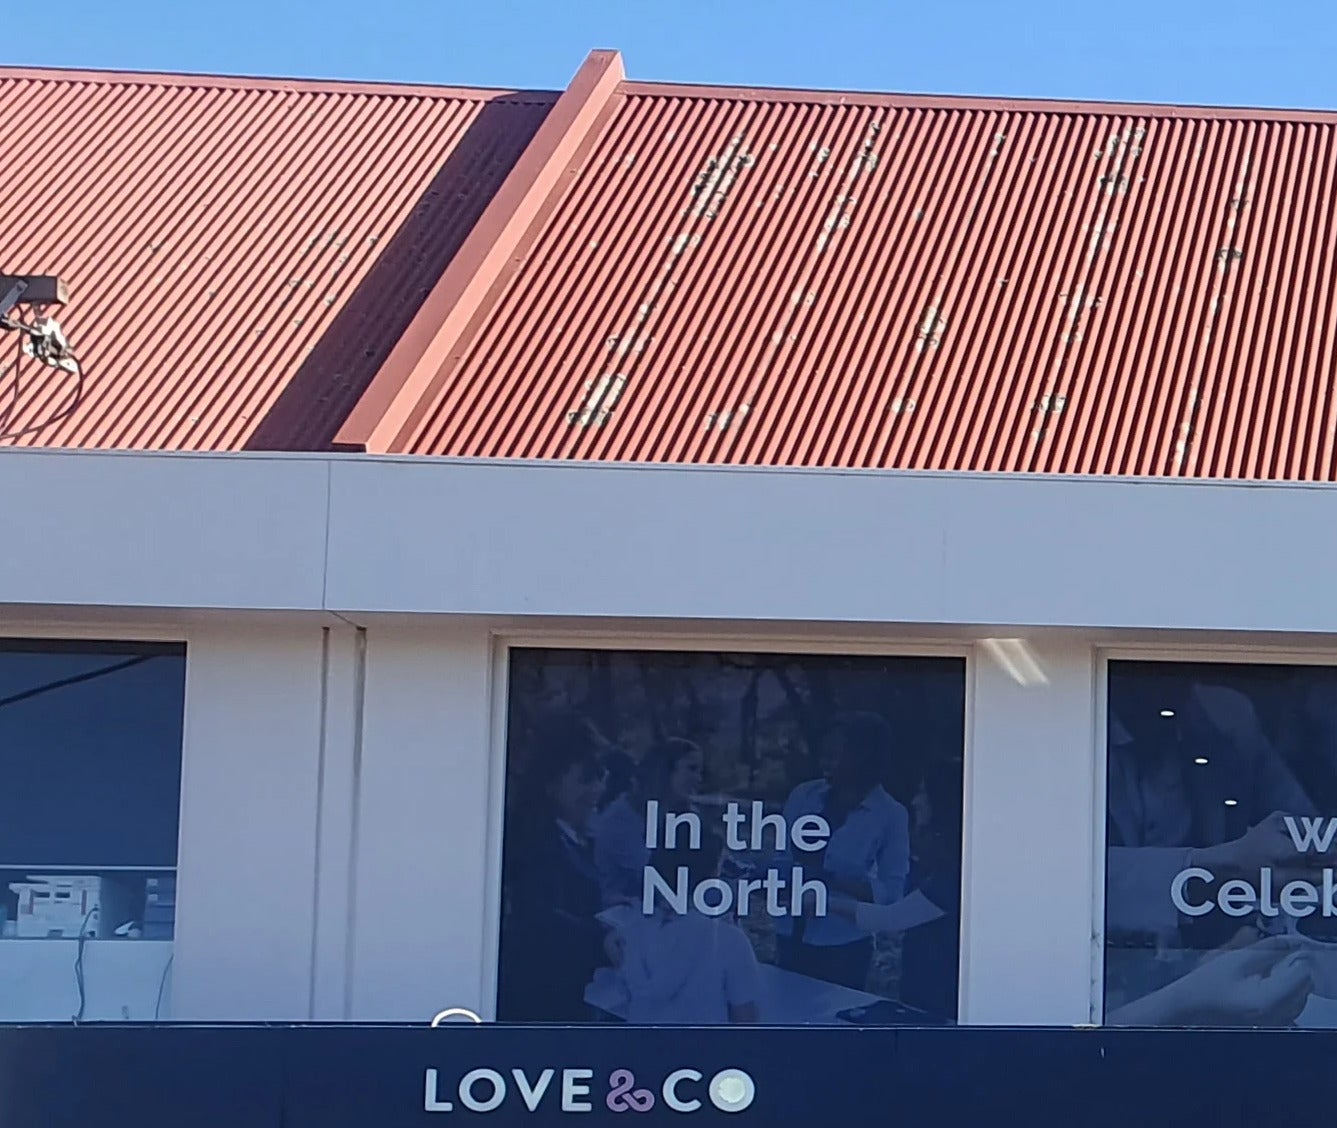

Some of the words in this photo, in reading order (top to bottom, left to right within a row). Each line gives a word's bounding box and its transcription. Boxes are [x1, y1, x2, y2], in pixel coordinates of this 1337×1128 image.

[645, 801, 701, 850] In
[722, 801, 830, 852] the
[640, 865, 829, 917] North
